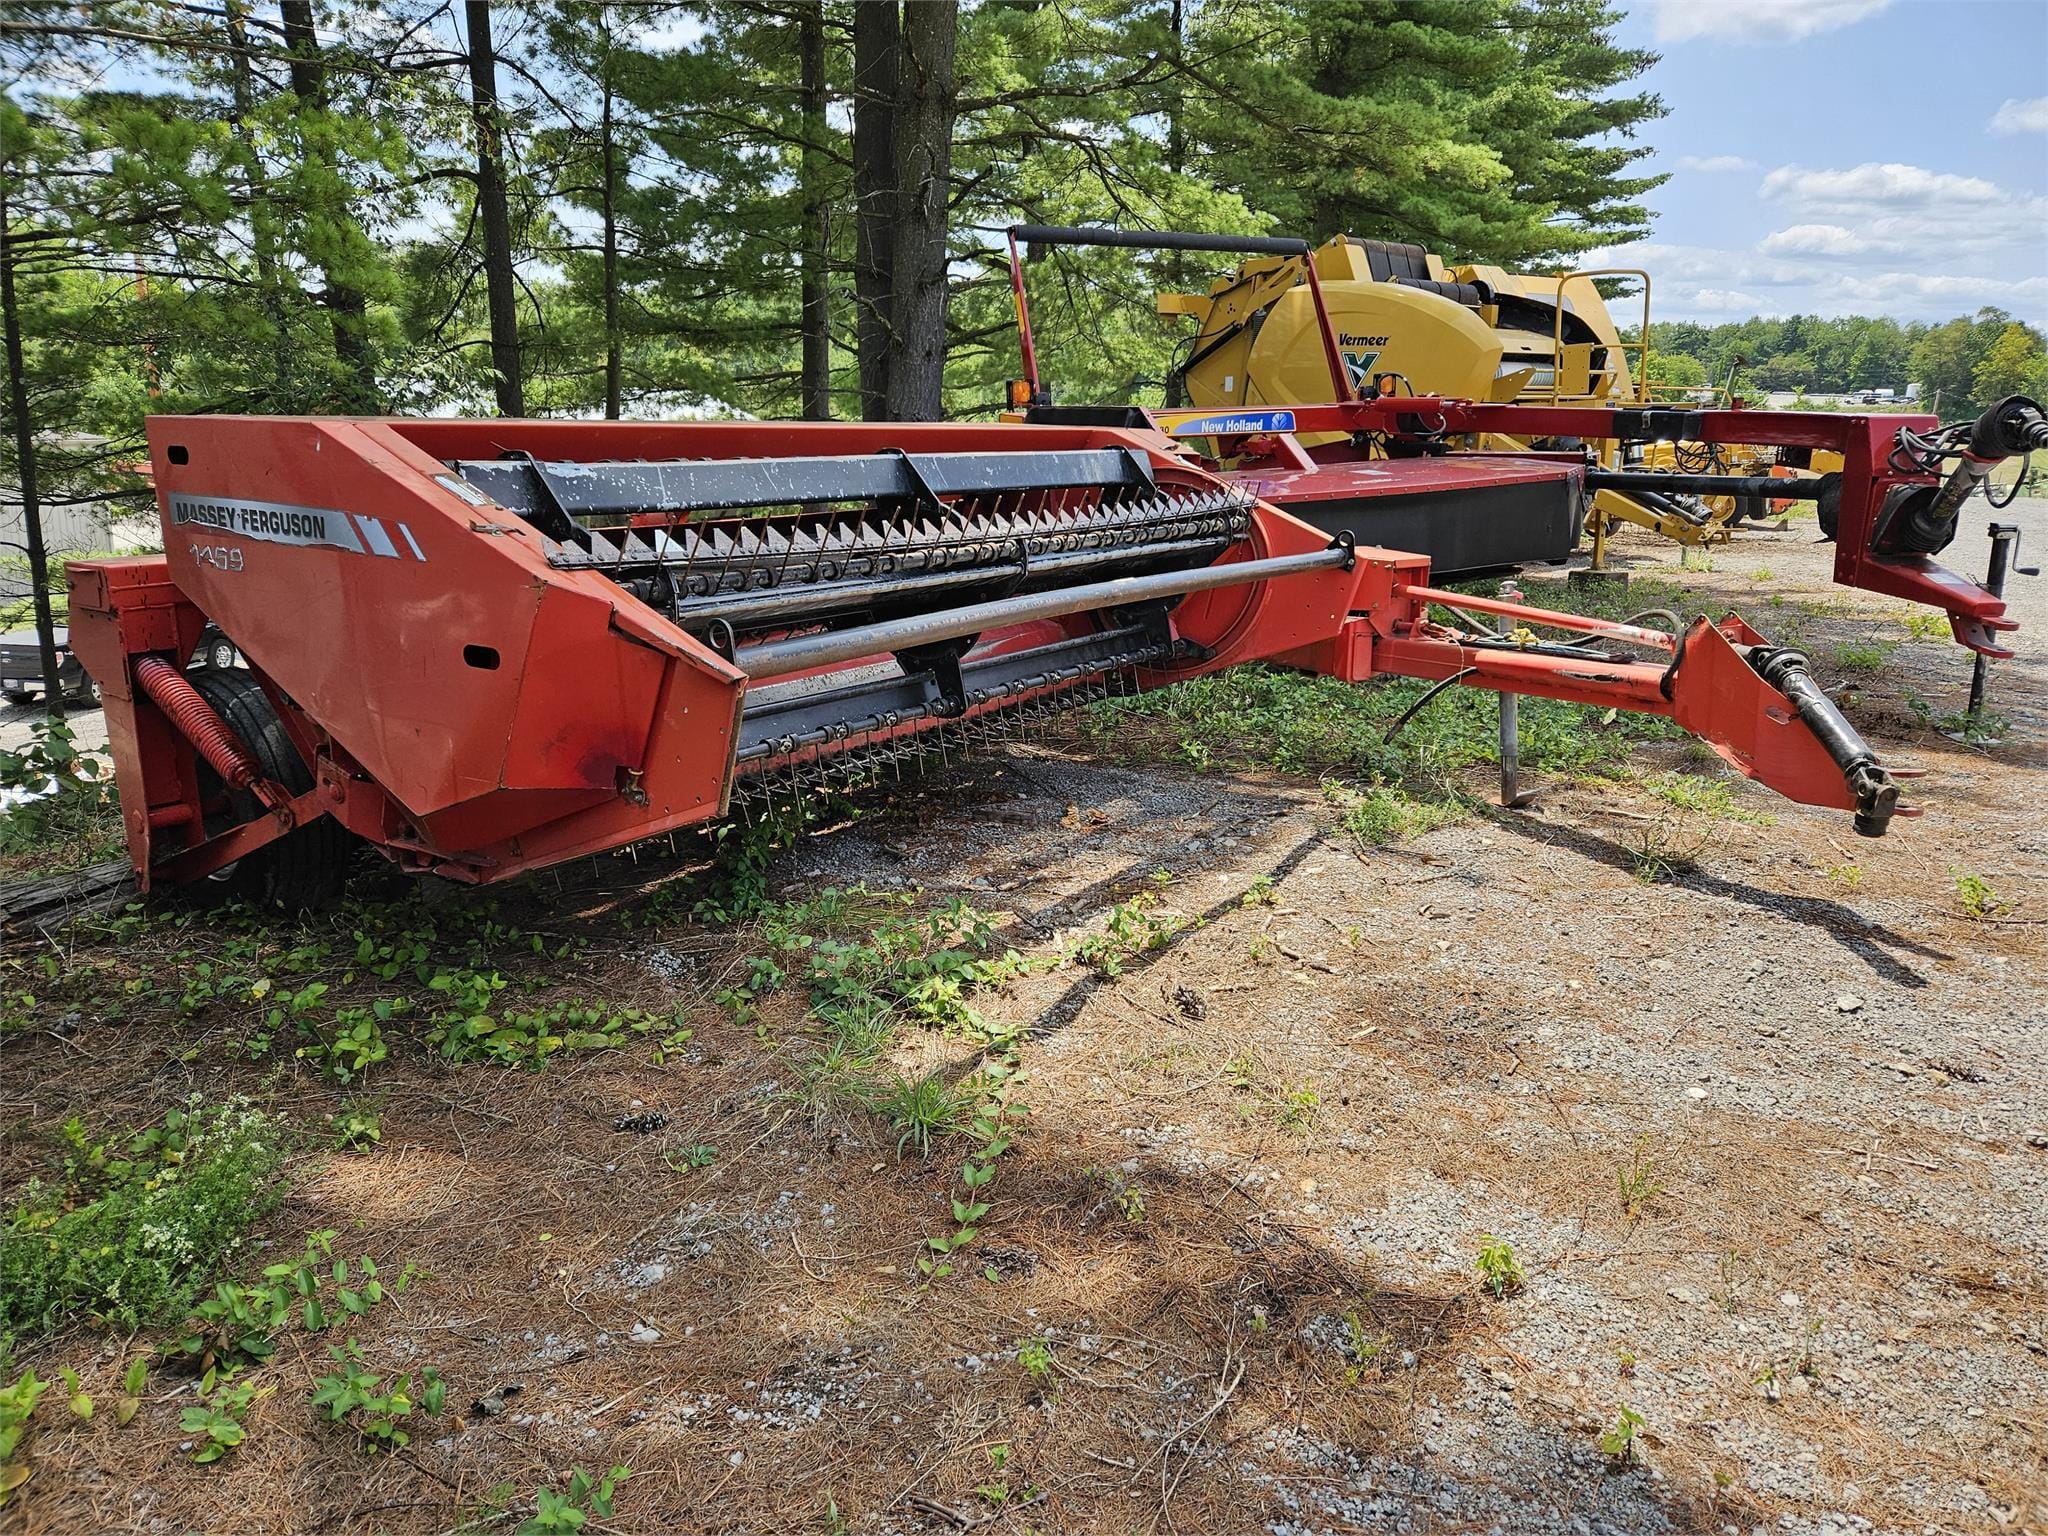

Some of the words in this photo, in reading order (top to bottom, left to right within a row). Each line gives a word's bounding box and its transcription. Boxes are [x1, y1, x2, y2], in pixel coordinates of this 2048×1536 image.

[1339, 333, 1389, 346] Vermeer
[1201, 420, 1223, 433] New
[1226, 418, 1263, 432] Holland
